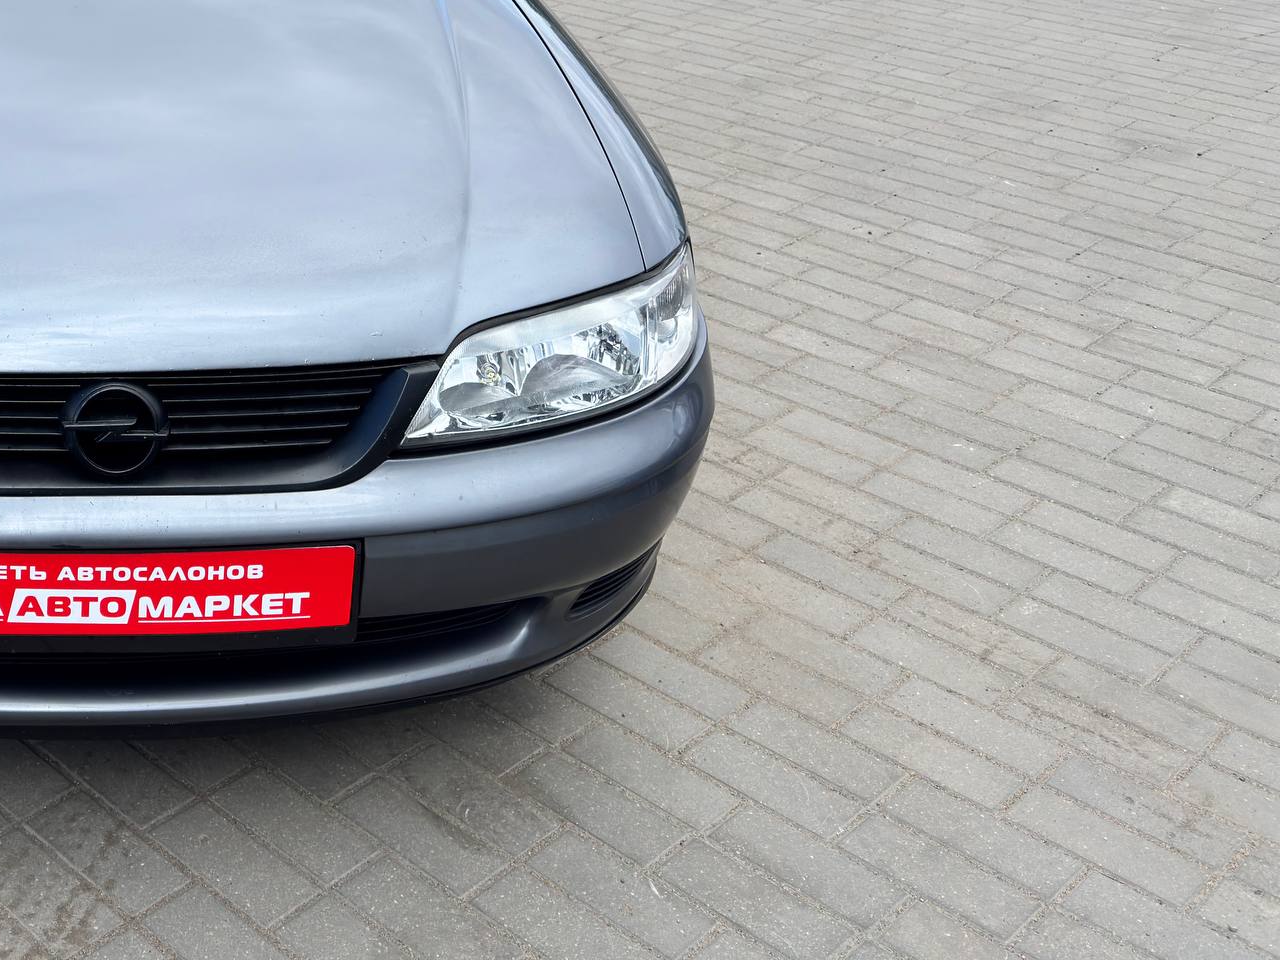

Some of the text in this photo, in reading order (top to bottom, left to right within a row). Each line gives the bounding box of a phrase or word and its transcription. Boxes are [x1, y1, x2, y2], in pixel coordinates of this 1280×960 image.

[57, 564, 264, 582] АВТОСАЛОНОВ
[19, 595, 127, 618] АВТО
[138, 591, 311, 619] МАРКЕТ
